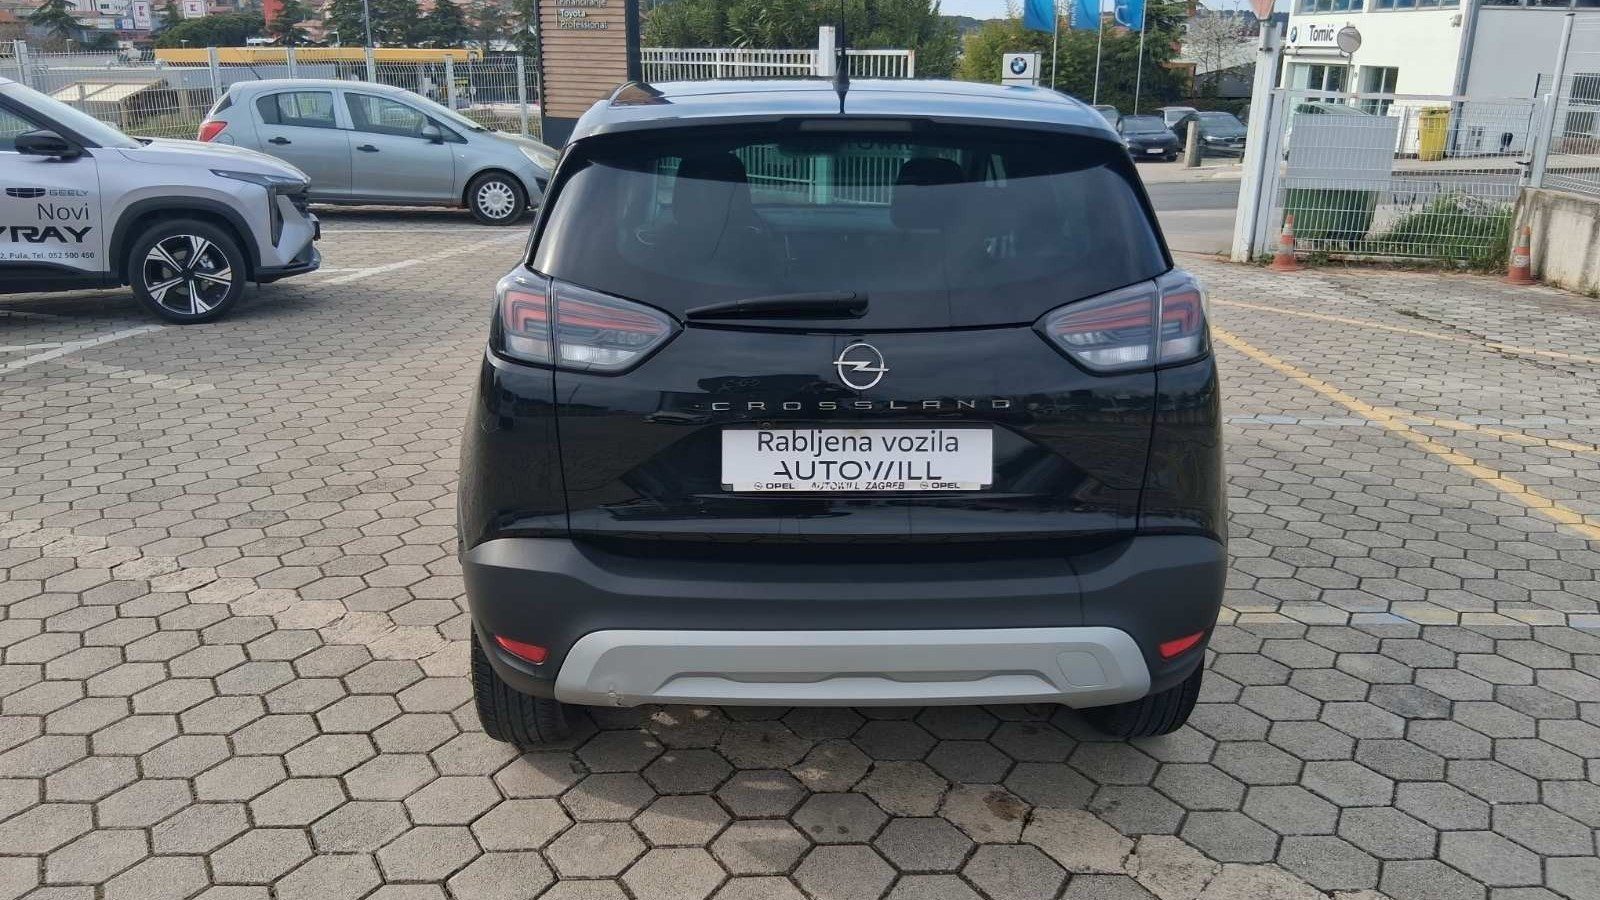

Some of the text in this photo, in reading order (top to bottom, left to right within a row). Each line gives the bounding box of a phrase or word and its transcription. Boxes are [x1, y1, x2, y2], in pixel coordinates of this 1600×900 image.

[560, 9, 587, 18] Toyota
[560, 19, 608, 29] Professional
[1309, 24, 1335, 42] Tomić
[38, 202, 89, 220] Novi
[0, 225, 93, 243] RAY
[711, 399, 1011, 411] CROSSLAND
[757, 430, 959, 457] Rabljena vozila
[772, 460, 942, 481] AUTOWILL
[865, 481, 905, 490] ZAGREB
